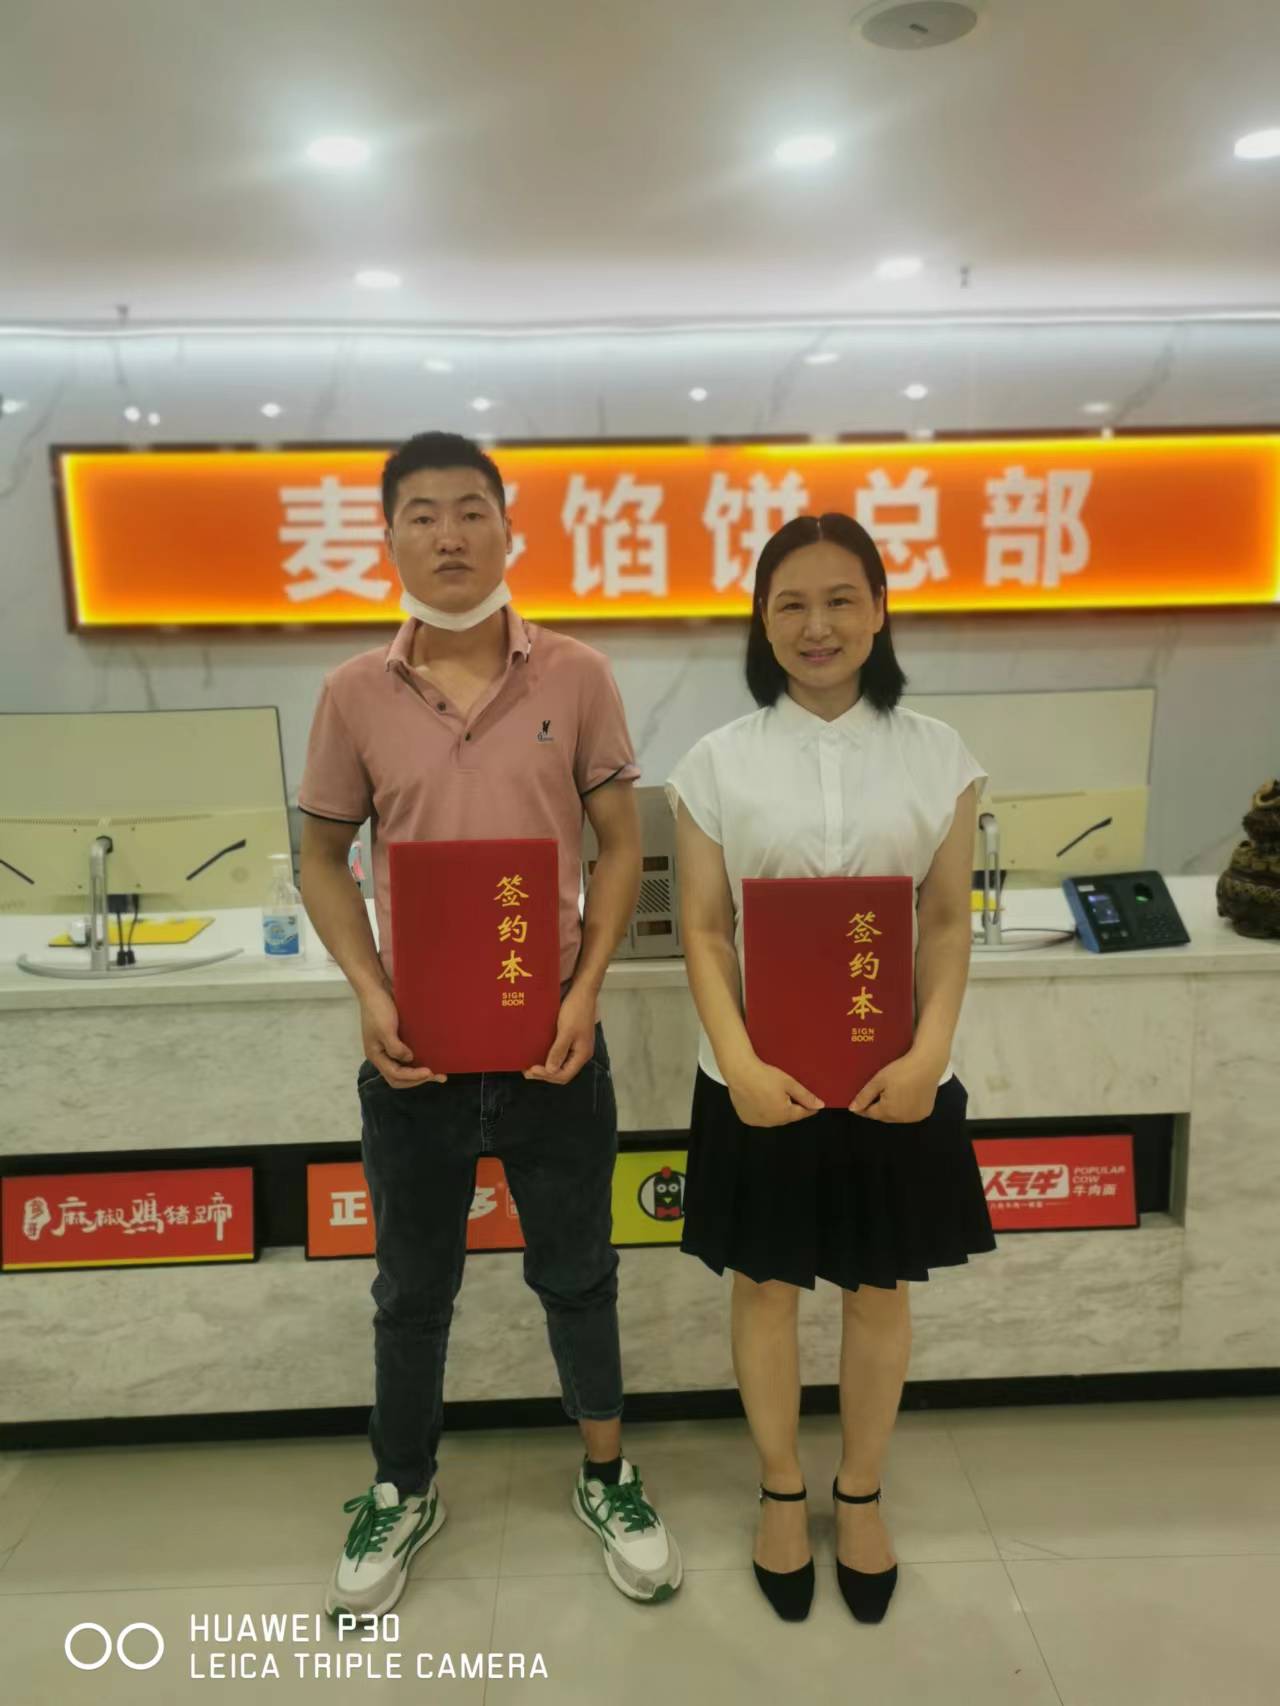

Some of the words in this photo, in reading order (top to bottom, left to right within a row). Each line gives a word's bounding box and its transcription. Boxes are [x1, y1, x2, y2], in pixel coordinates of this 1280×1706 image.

[278, 466, 1093, 602] 麦馅饼总部
[494, 874, 533, 984] 签约本
[846, 911, 883, 1020] 签约本
[984, 1166, 1064, 1196] 人气牛
[1072, 1175, 1100, 1184] COW
[1073, 1165, 1126, 1175] POPULAR
